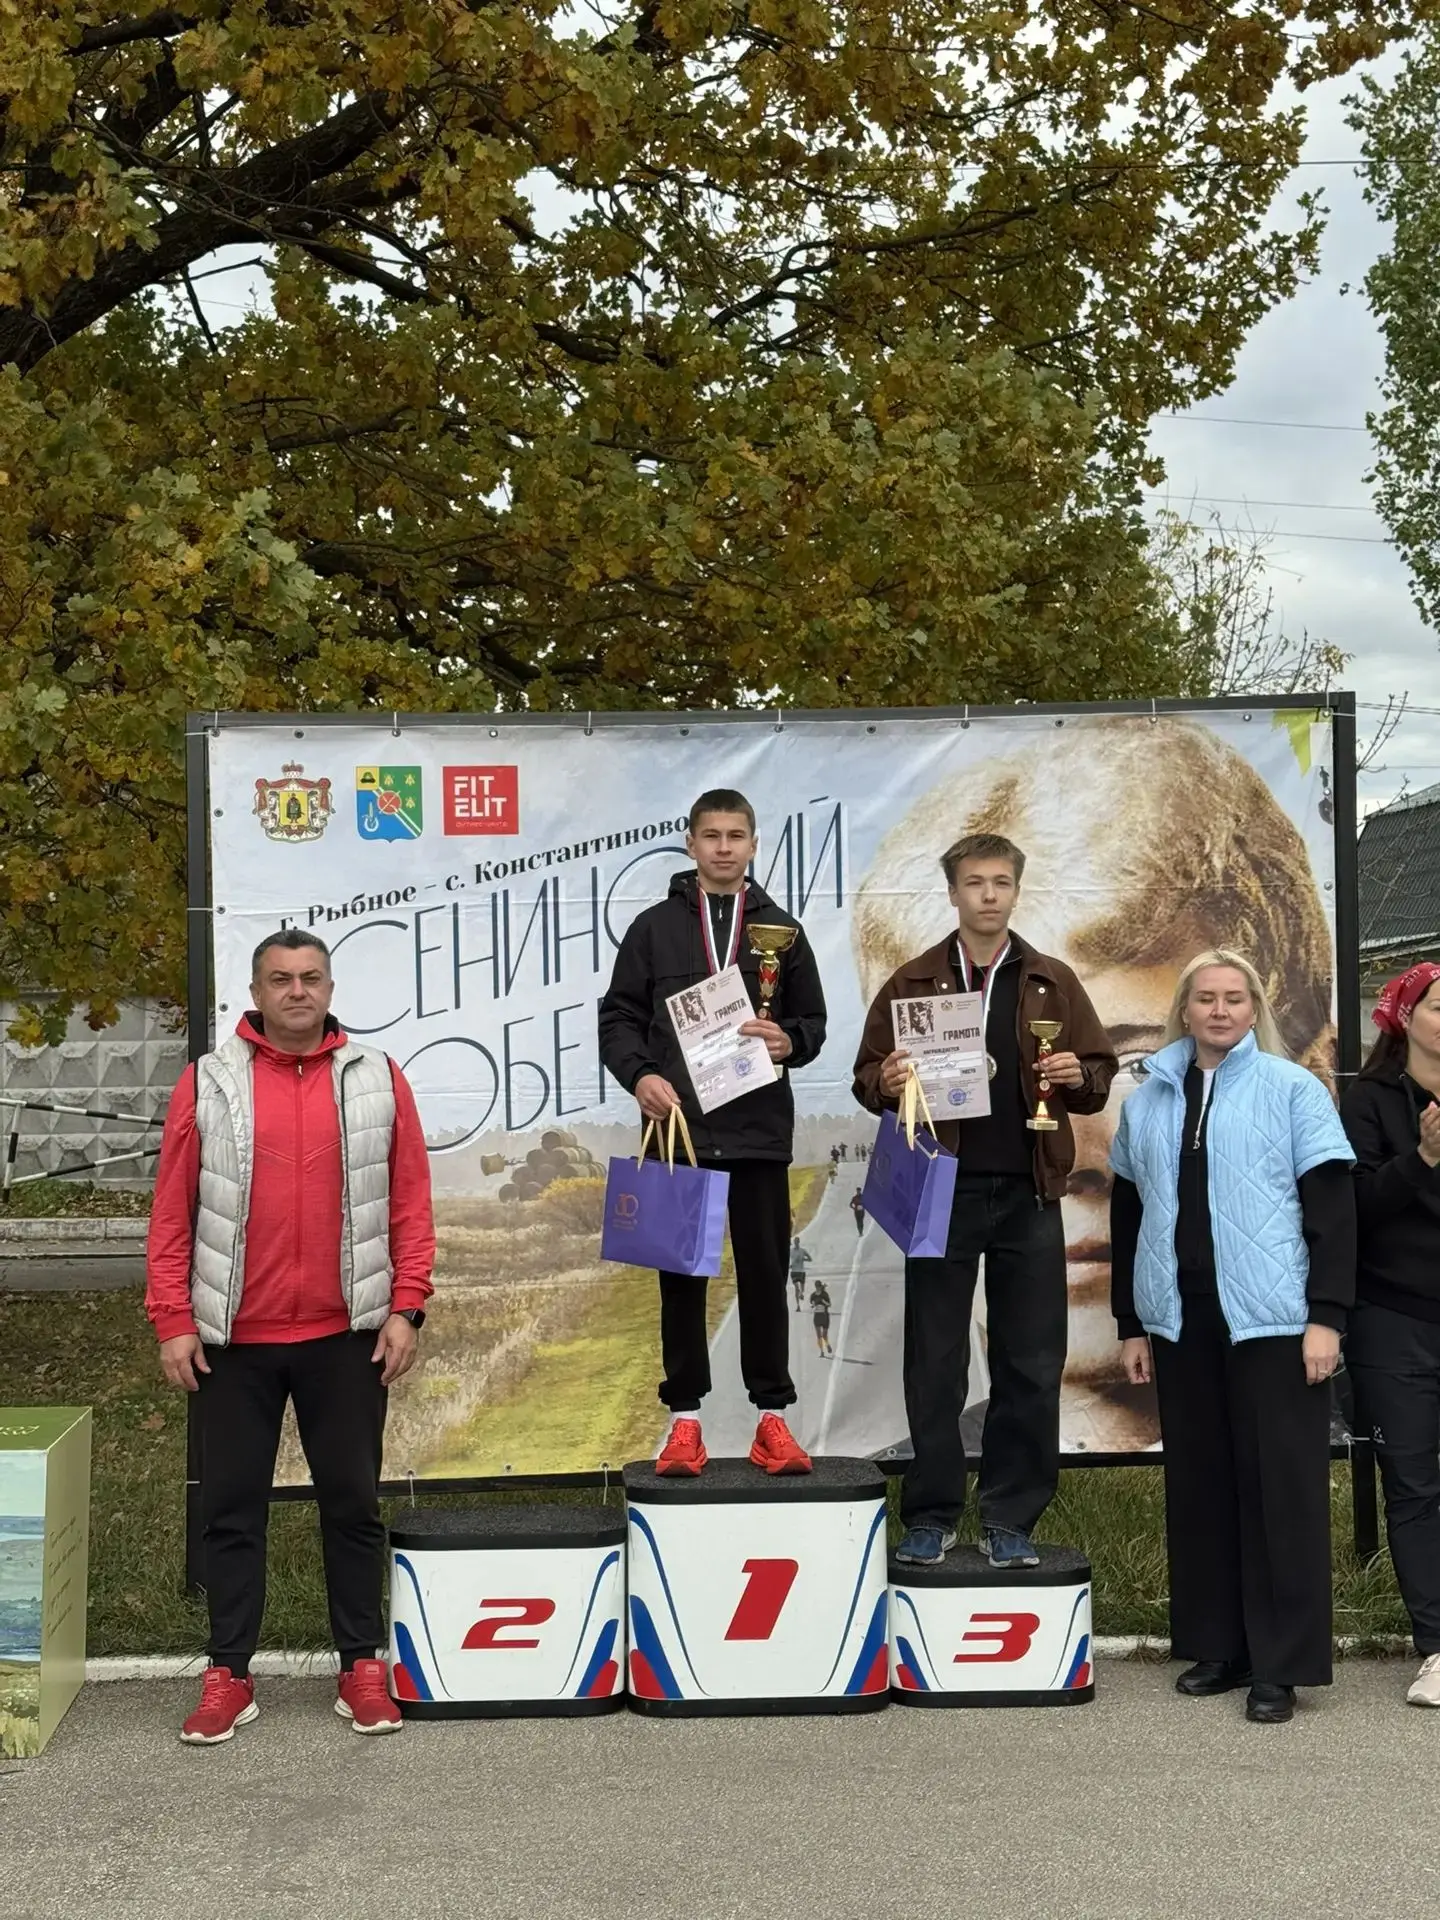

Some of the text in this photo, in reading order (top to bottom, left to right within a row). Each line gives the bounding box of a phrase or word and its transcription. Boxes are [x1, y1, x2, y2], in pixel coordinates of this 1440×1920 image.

[454, 775, 495, 796] FIT
[455, 797, 507, 817] ELIT
[307, 884, 416, 928] Рыбное
[445, 874, 465, 891] с.
[474, 815, 690, 884] Константиново
[714, 998, 747, 1020] ГРАМОТА
[943, 1027, 980, 1041] ГРАМОТА
[724, 1558, 799, 1640] 1
[461, 1598, 555, 1649] 2
[953, 1613, 1040, 1663] 3
